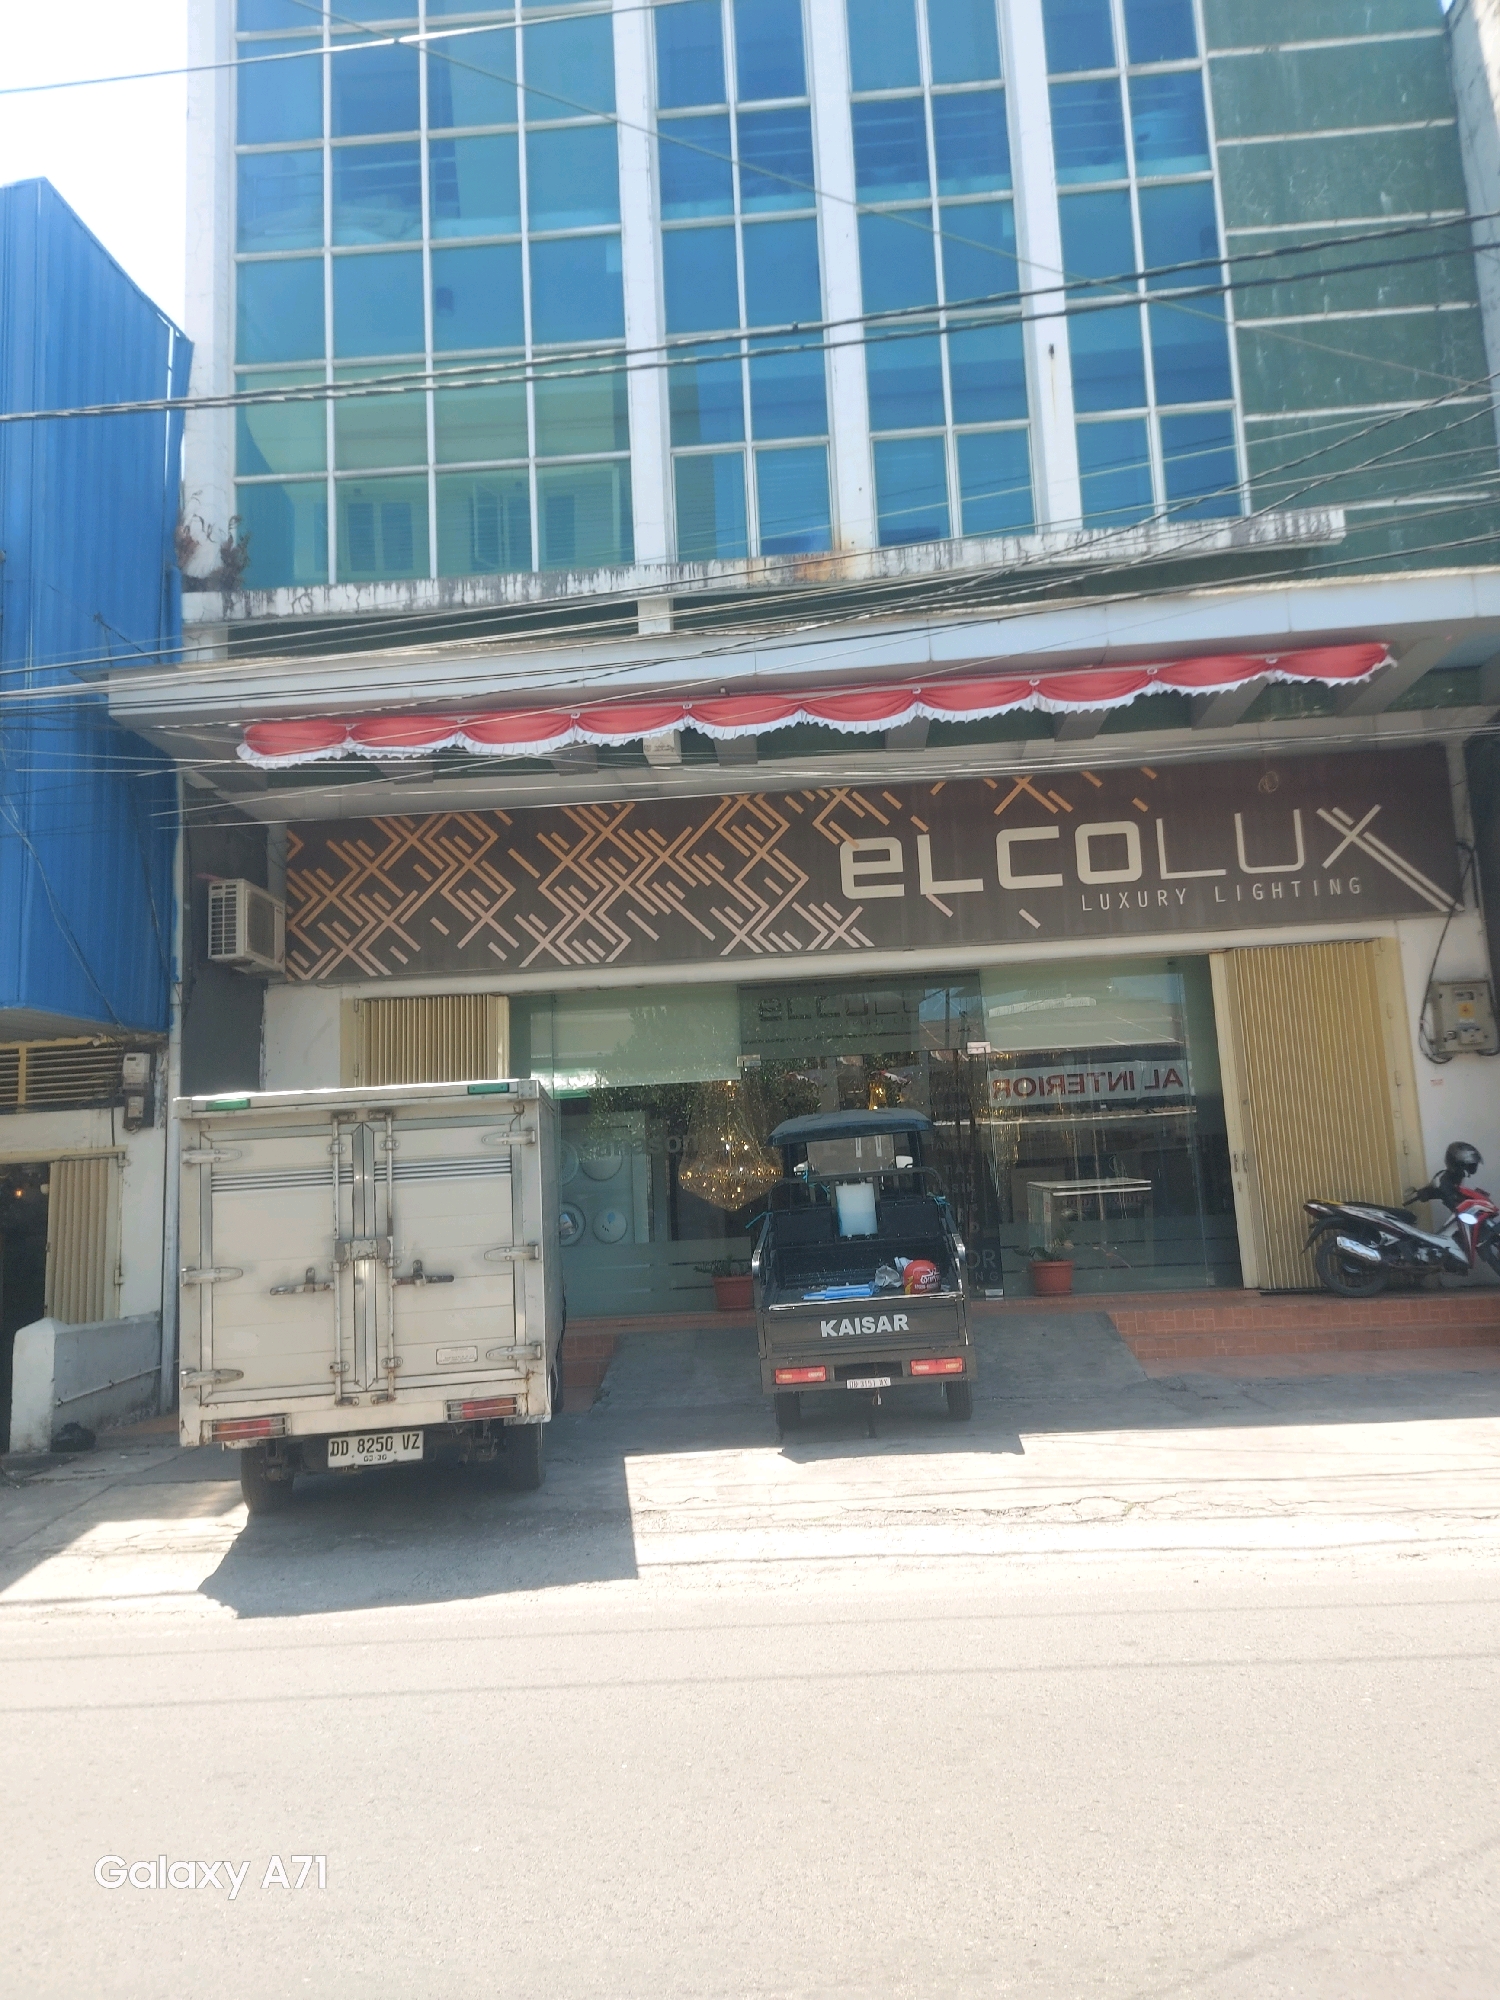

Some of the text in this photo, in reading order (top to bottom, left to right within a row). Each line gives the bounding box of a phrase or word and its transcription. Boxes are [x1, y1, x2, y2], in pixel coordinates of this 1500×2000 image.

[1081, 877, 1361, 911] LUXURY LIGHTING
[820, 1313, 910, 1338] KAISAR
[330, 1433, 420, 1457] DD 8250 VZ
